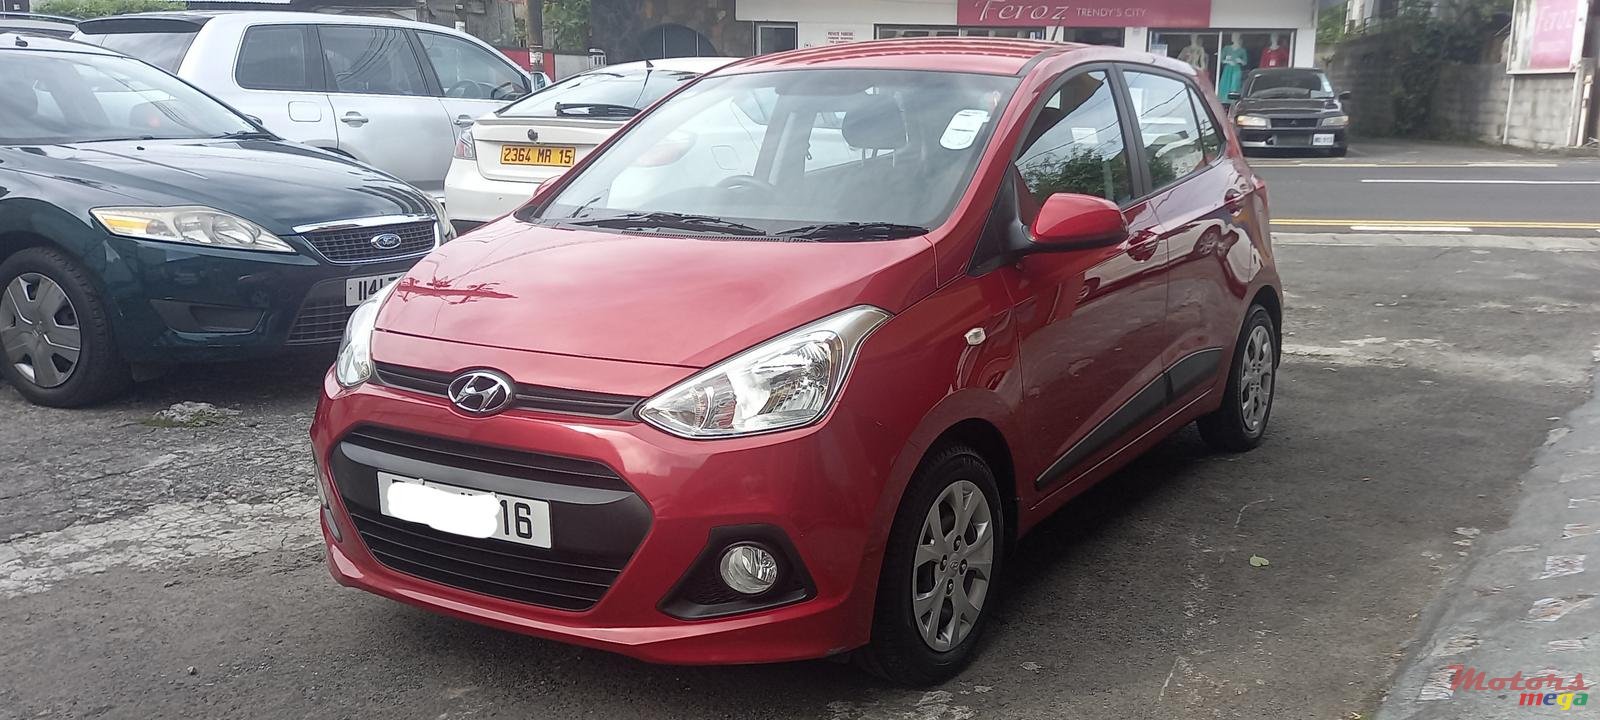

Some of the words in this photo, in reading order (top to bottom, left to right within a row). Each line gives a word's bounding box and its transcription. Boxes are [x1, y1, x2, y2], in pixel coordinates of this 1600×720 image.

[975, 0, 1069, 21] Feroz
[1076, 7, 1122, 17] TRENDY'S
[1124, 7, 1147, 17] CITY
[503, 147, 531, 162] 2364
[537, 148, 552, 163] MR
[559, 149, 572, 164] 15
[499, 499, 532, 540] 16
